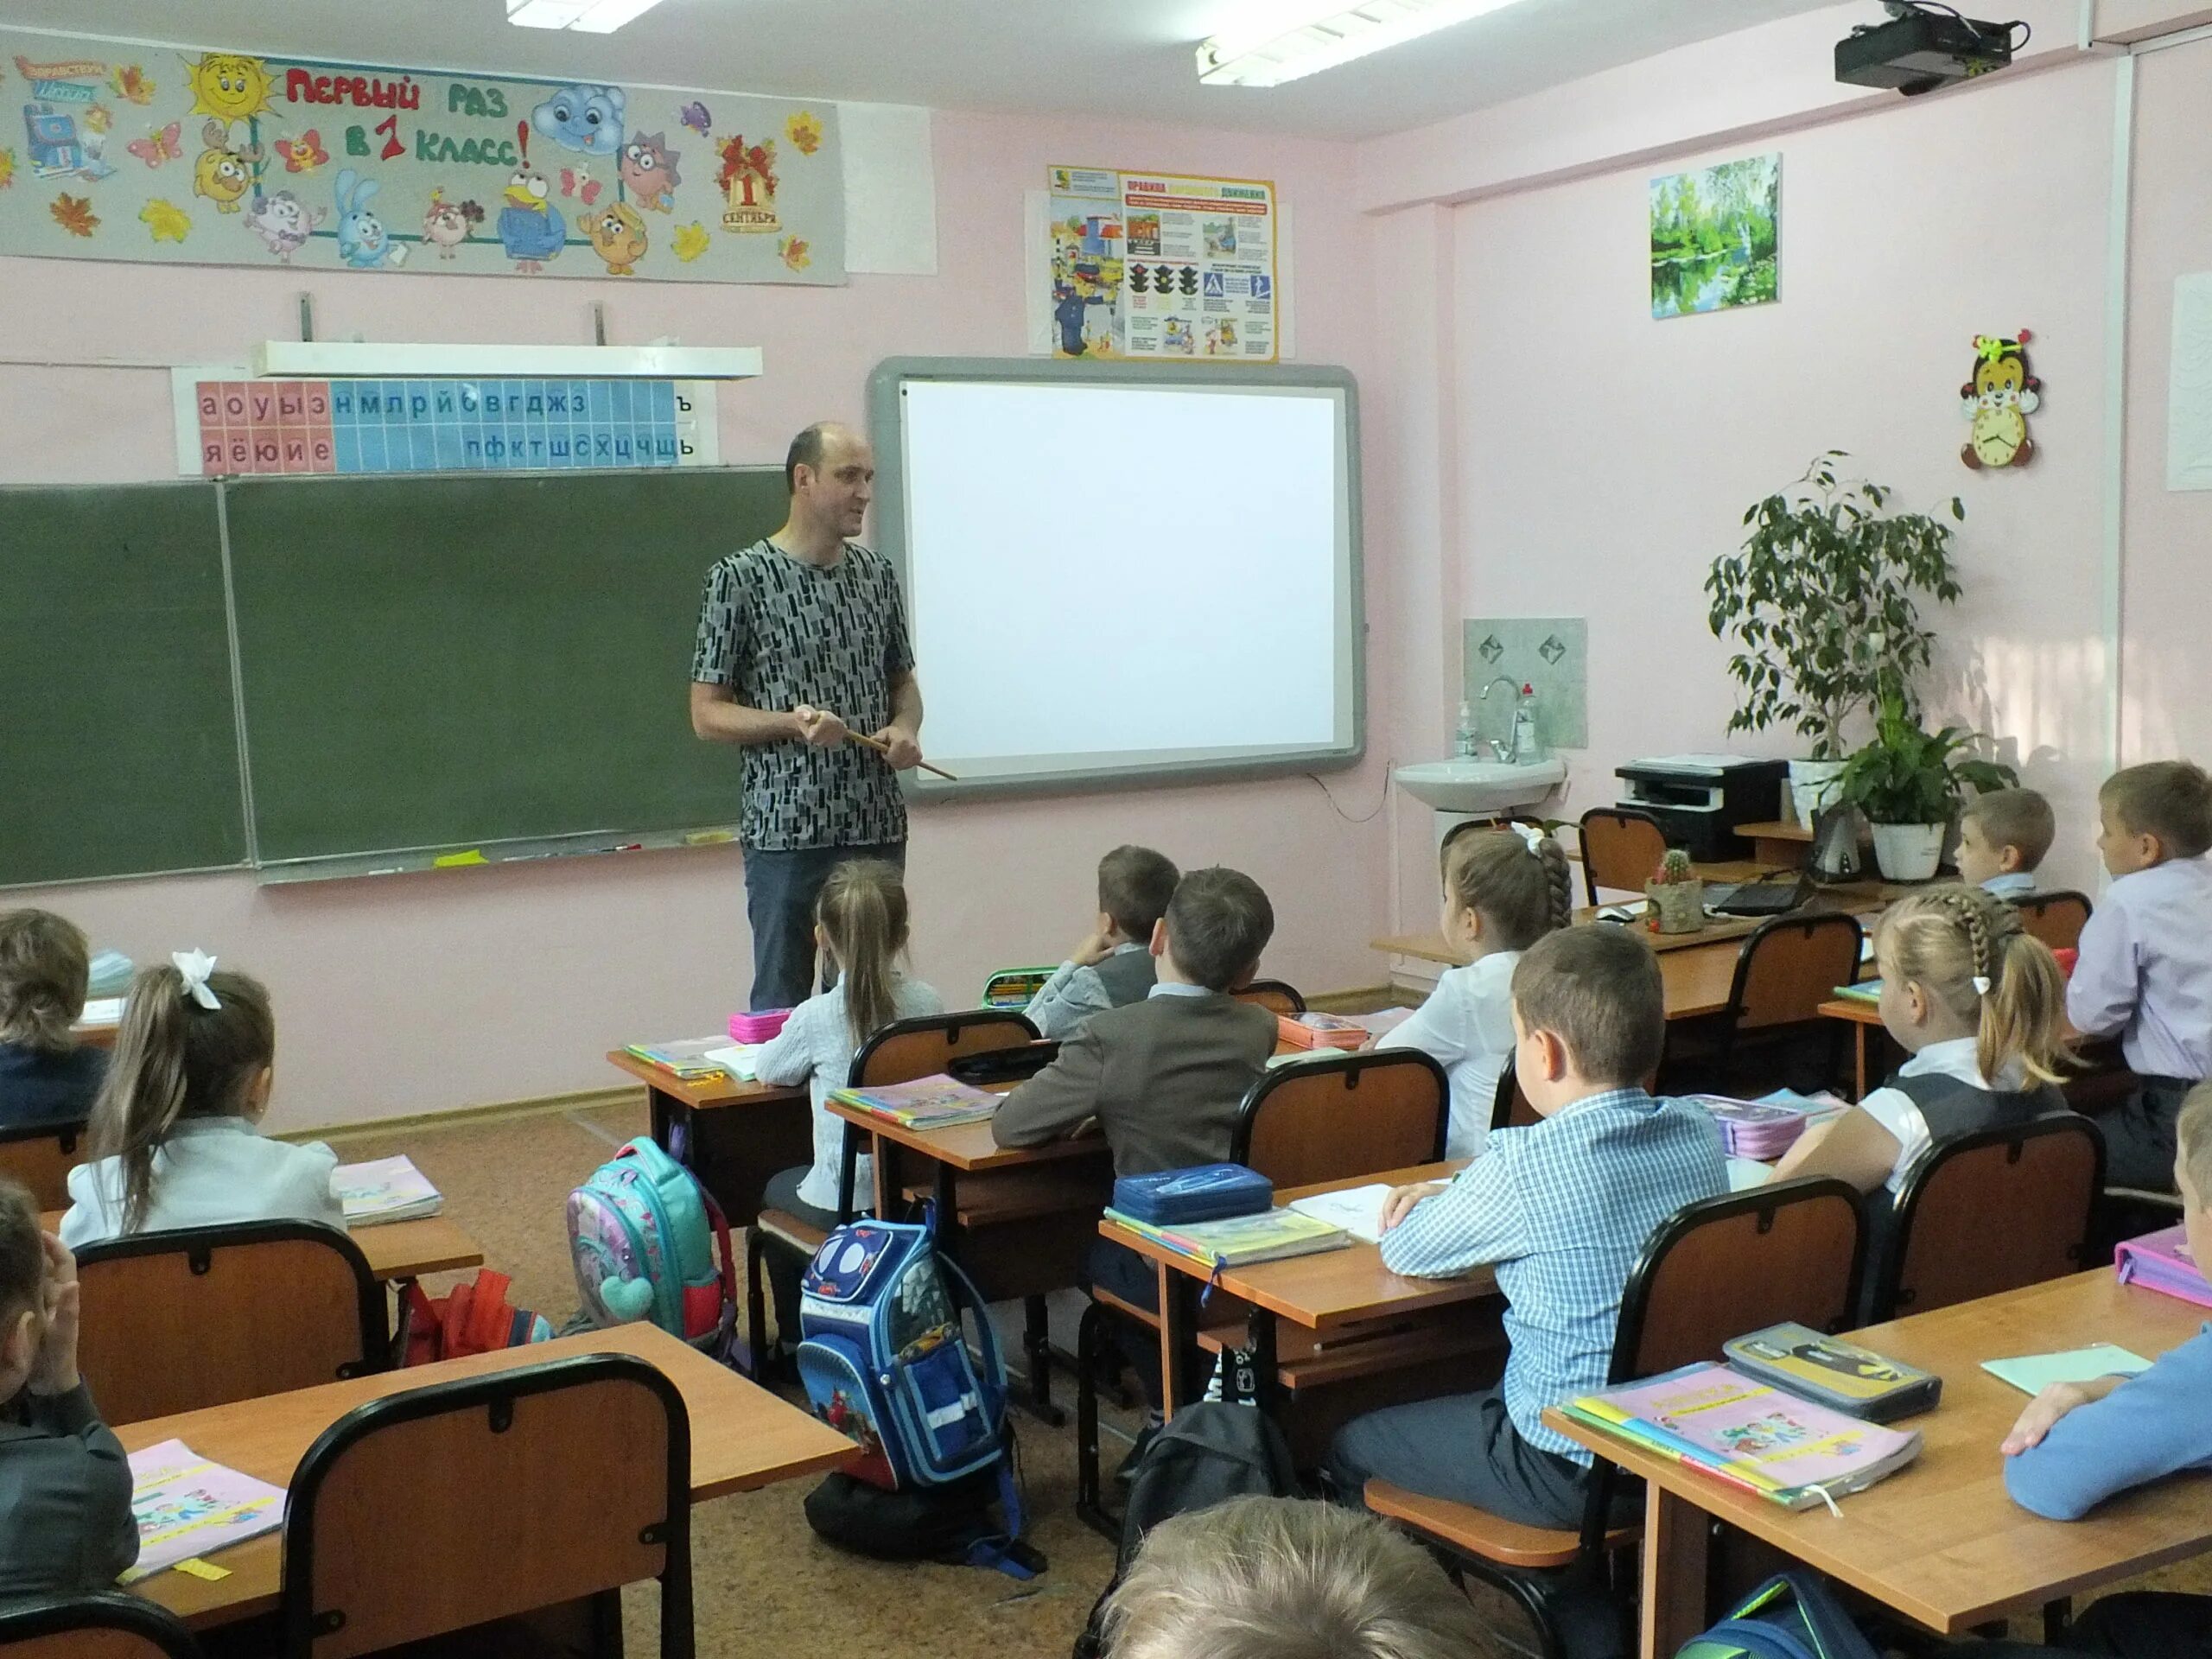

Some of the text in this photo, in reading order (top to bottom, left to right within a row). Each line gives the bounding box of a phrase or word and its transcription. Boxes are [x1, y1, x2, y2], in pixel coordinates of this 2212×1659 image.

[448, 83, 508, 118] РАЗ
[346, 124, 372, 156] В
[375, 114, 406, 162] 1
[723, 212, 776, 223] СЕНТЯБРЯ
